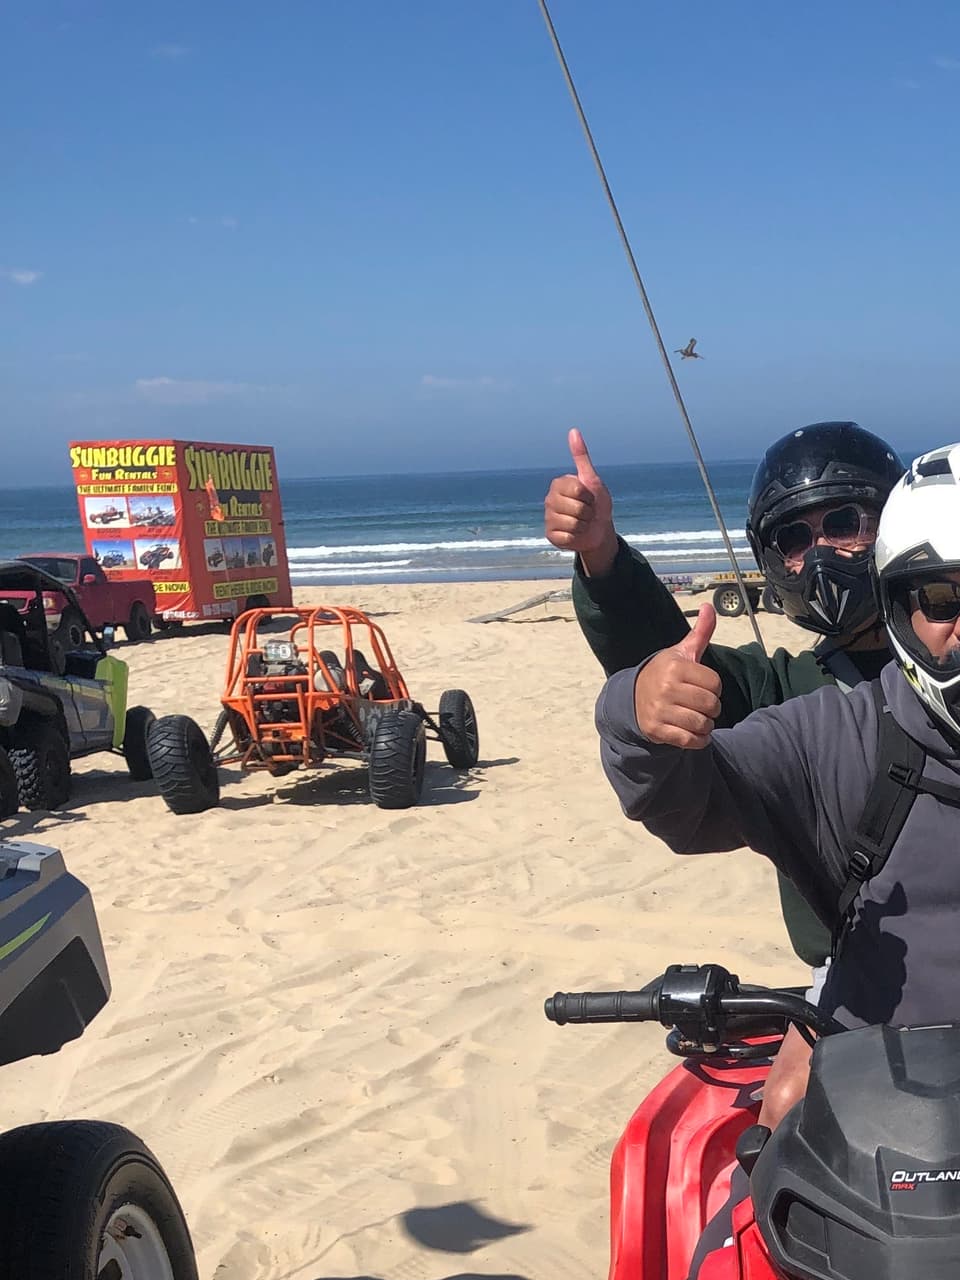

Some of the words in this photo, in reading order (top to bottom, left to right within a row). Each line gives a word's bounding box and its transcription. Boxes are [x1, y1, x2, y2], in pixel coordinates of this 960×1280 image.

[70, 445, 177, 468] SUNBUGGIE
[185, 446, 272, 490] SUNBUGGIE
[91, 468, 112, 480] FUN
[115, 468, 158, 480] RENTALS
